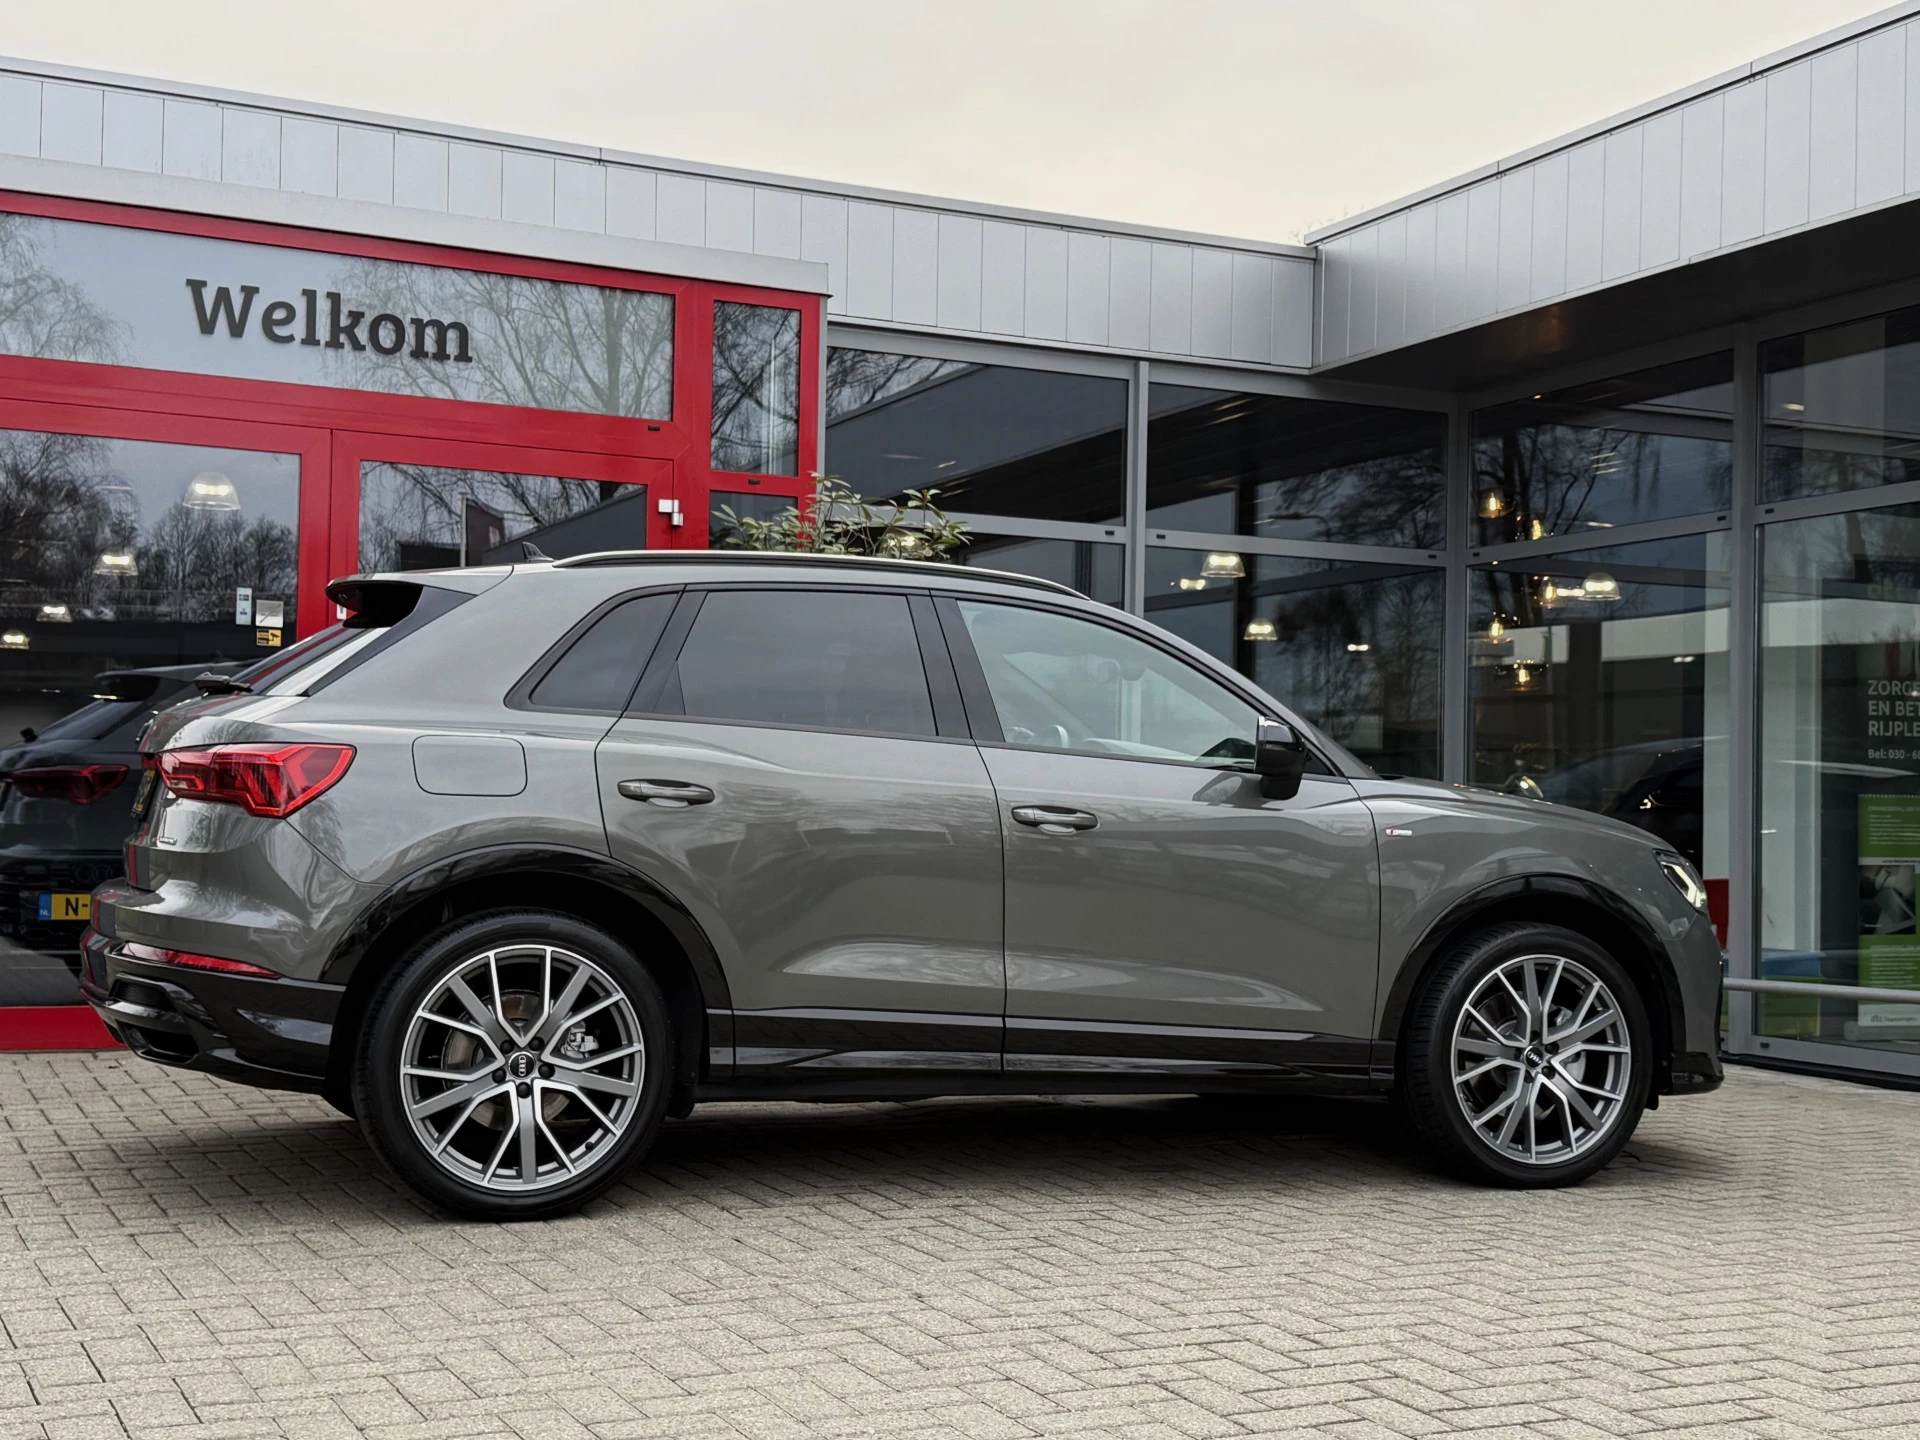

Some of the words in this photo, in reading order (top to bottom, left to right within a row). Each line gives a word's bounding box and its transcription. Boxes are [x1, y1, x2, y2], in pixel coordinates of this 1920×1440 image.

[185, 278, 473, 363] Welkom
[1868, 700, 1890, 716] EN
[1868, 721, 1920, 737] RIJPLE
[1868, 749, 1887, 759] Bel:
[1888, 749, 1905, 760] 030
